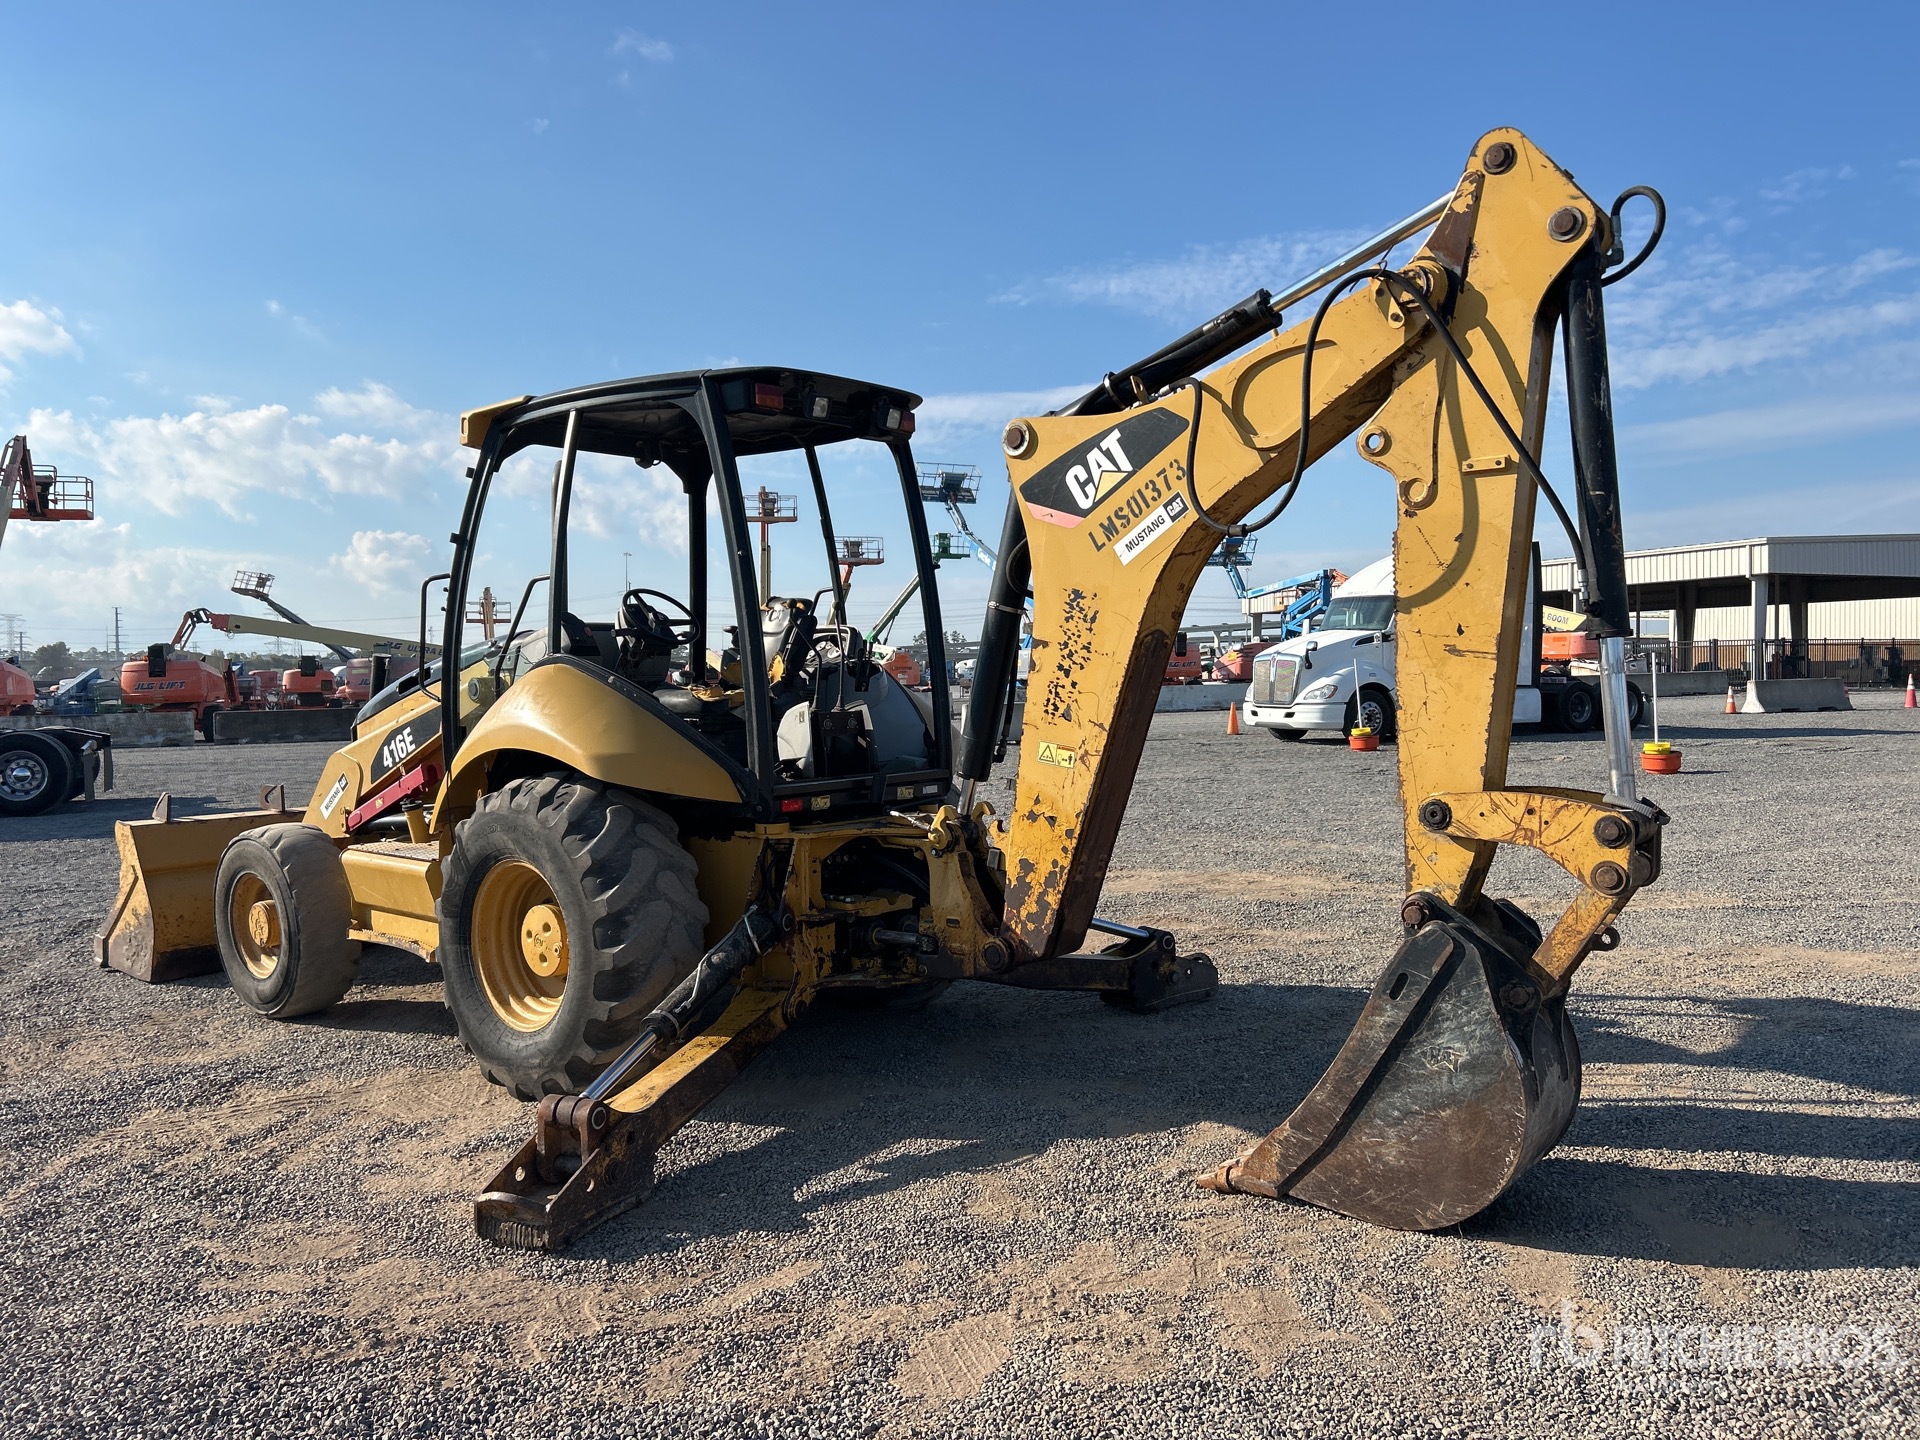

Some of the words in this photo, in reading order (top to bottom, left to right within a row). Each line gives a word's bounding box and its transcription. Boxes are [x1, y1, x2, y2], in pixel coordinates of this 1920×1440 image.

[1065, 428, 1133, 510] CAT
[1125, 515, 1166, 553] MUSTANG
[1167, 497, 1185, 515] CAT
[1547, 613, 1569, 625] BOOM
[407, 644, 437, 655] ULRA
[134, 681, 155, 690] JLG
[158, 681, 187, 690] LIFT
[383, 726, 416, 768] 416E
[325, 787, 341, 811] MUSTANG
